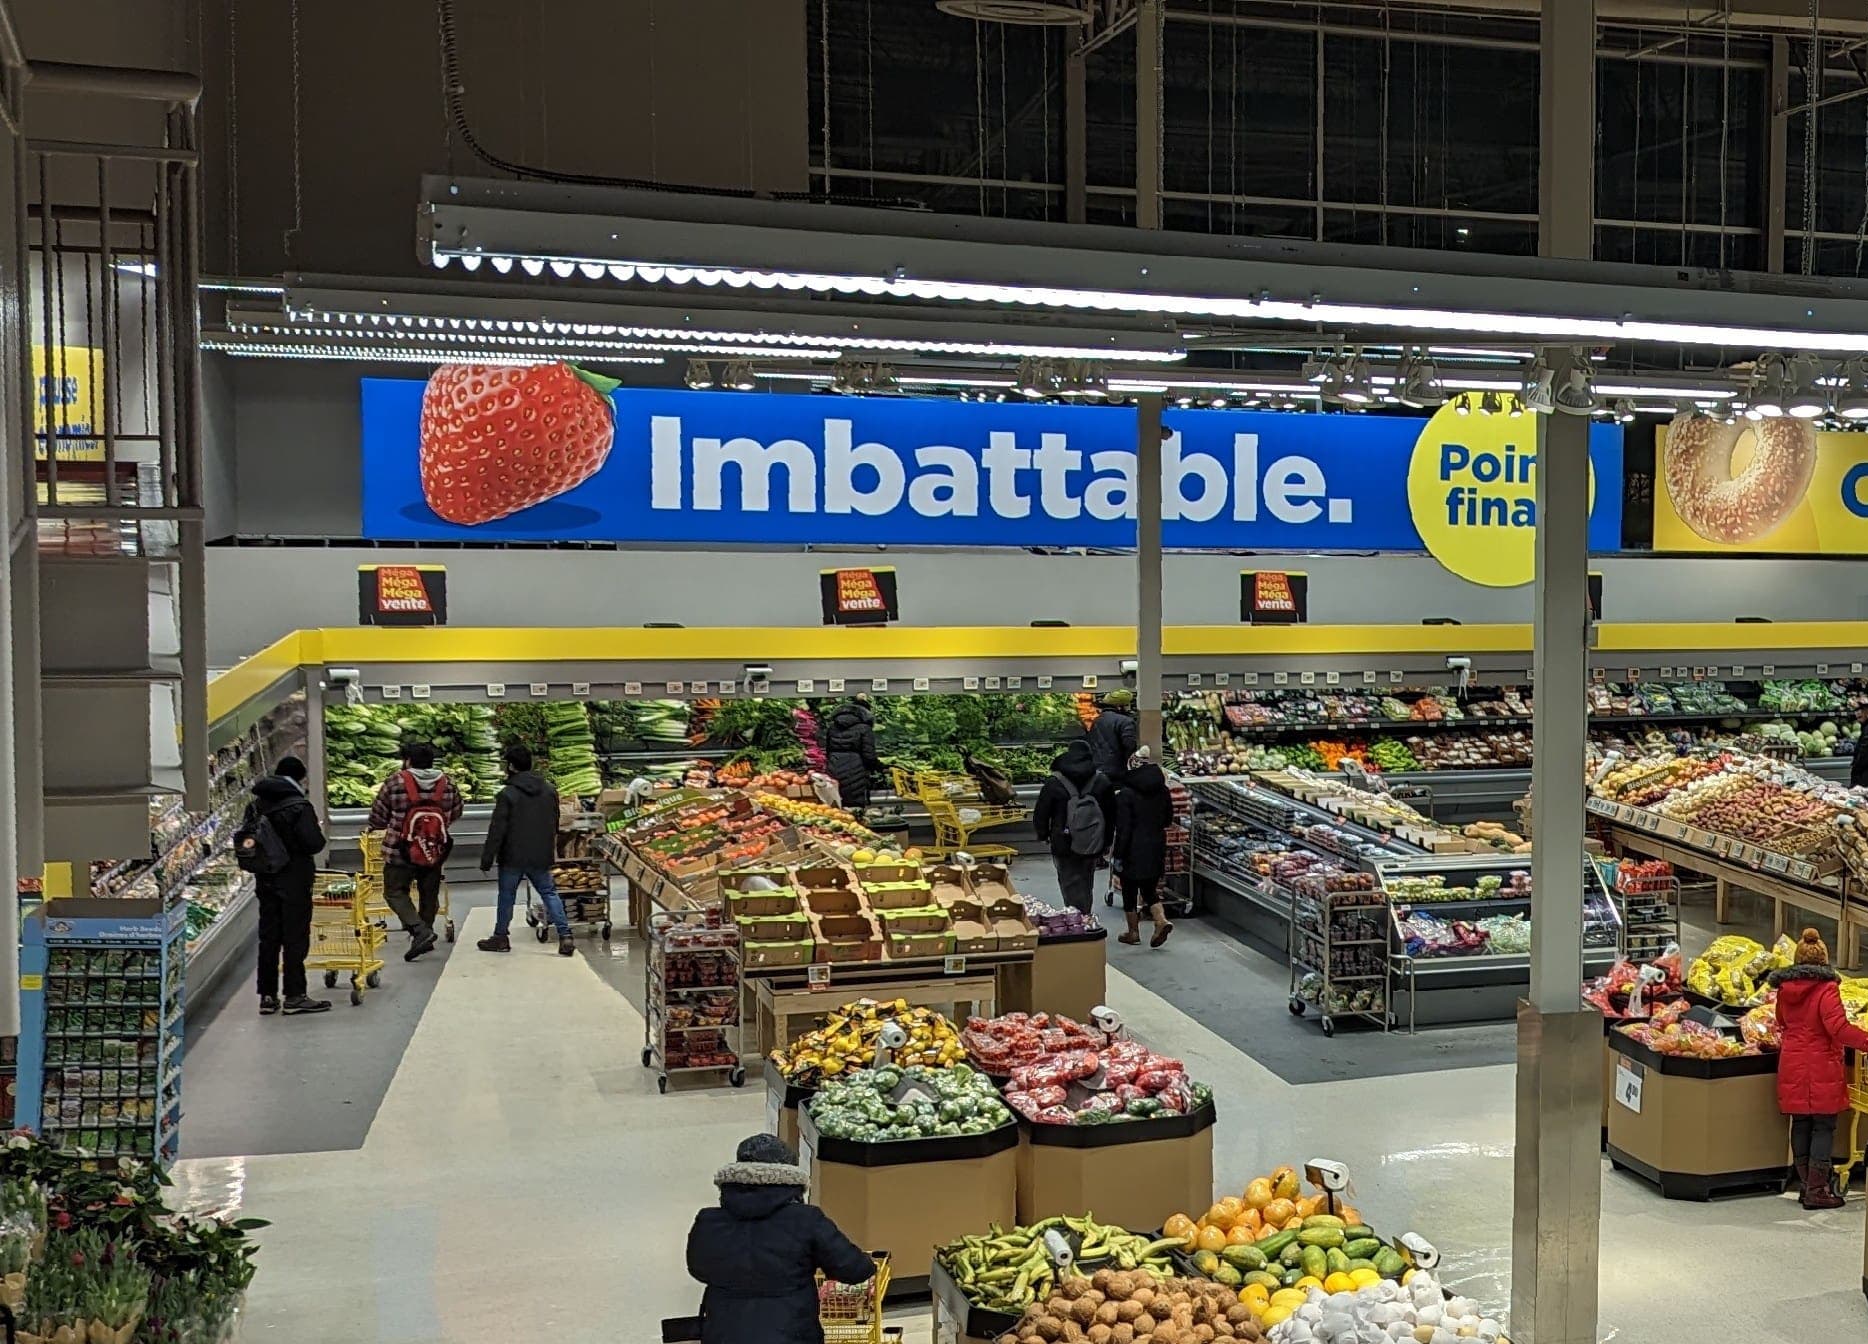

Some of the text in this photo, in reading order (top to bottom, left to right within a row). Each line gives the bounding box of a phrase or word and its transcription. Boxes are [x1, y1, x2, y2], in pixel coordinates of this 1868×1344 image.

[651, 415, 1353, 523] Imbattable.
[1440, 444, 1537, 483] Poin
[1446, 487, 1538, 527] fina
[381, 598, 427, 609] vente
